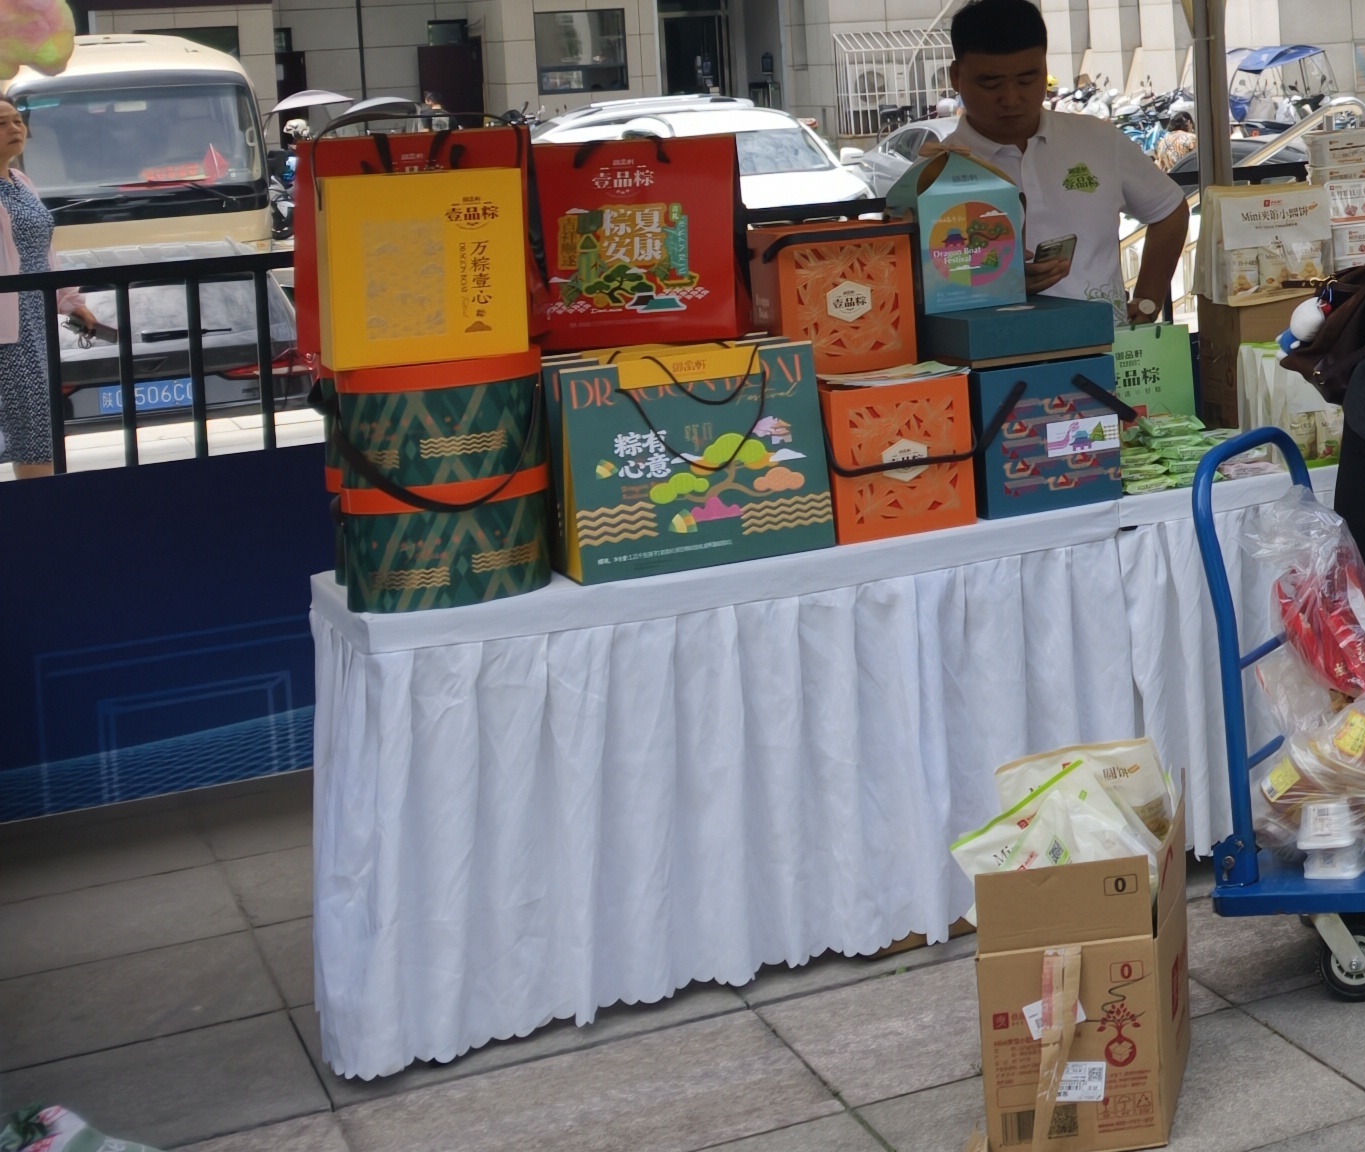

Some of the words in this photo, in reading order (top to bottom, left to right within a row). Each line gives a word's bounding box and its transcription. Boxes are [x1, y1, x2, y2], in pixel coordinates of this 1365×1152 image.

[933, 249, 962, 259] Dragon
[944, 255, 972, 264] Festival
[618, 452, 672, 479] 心意
